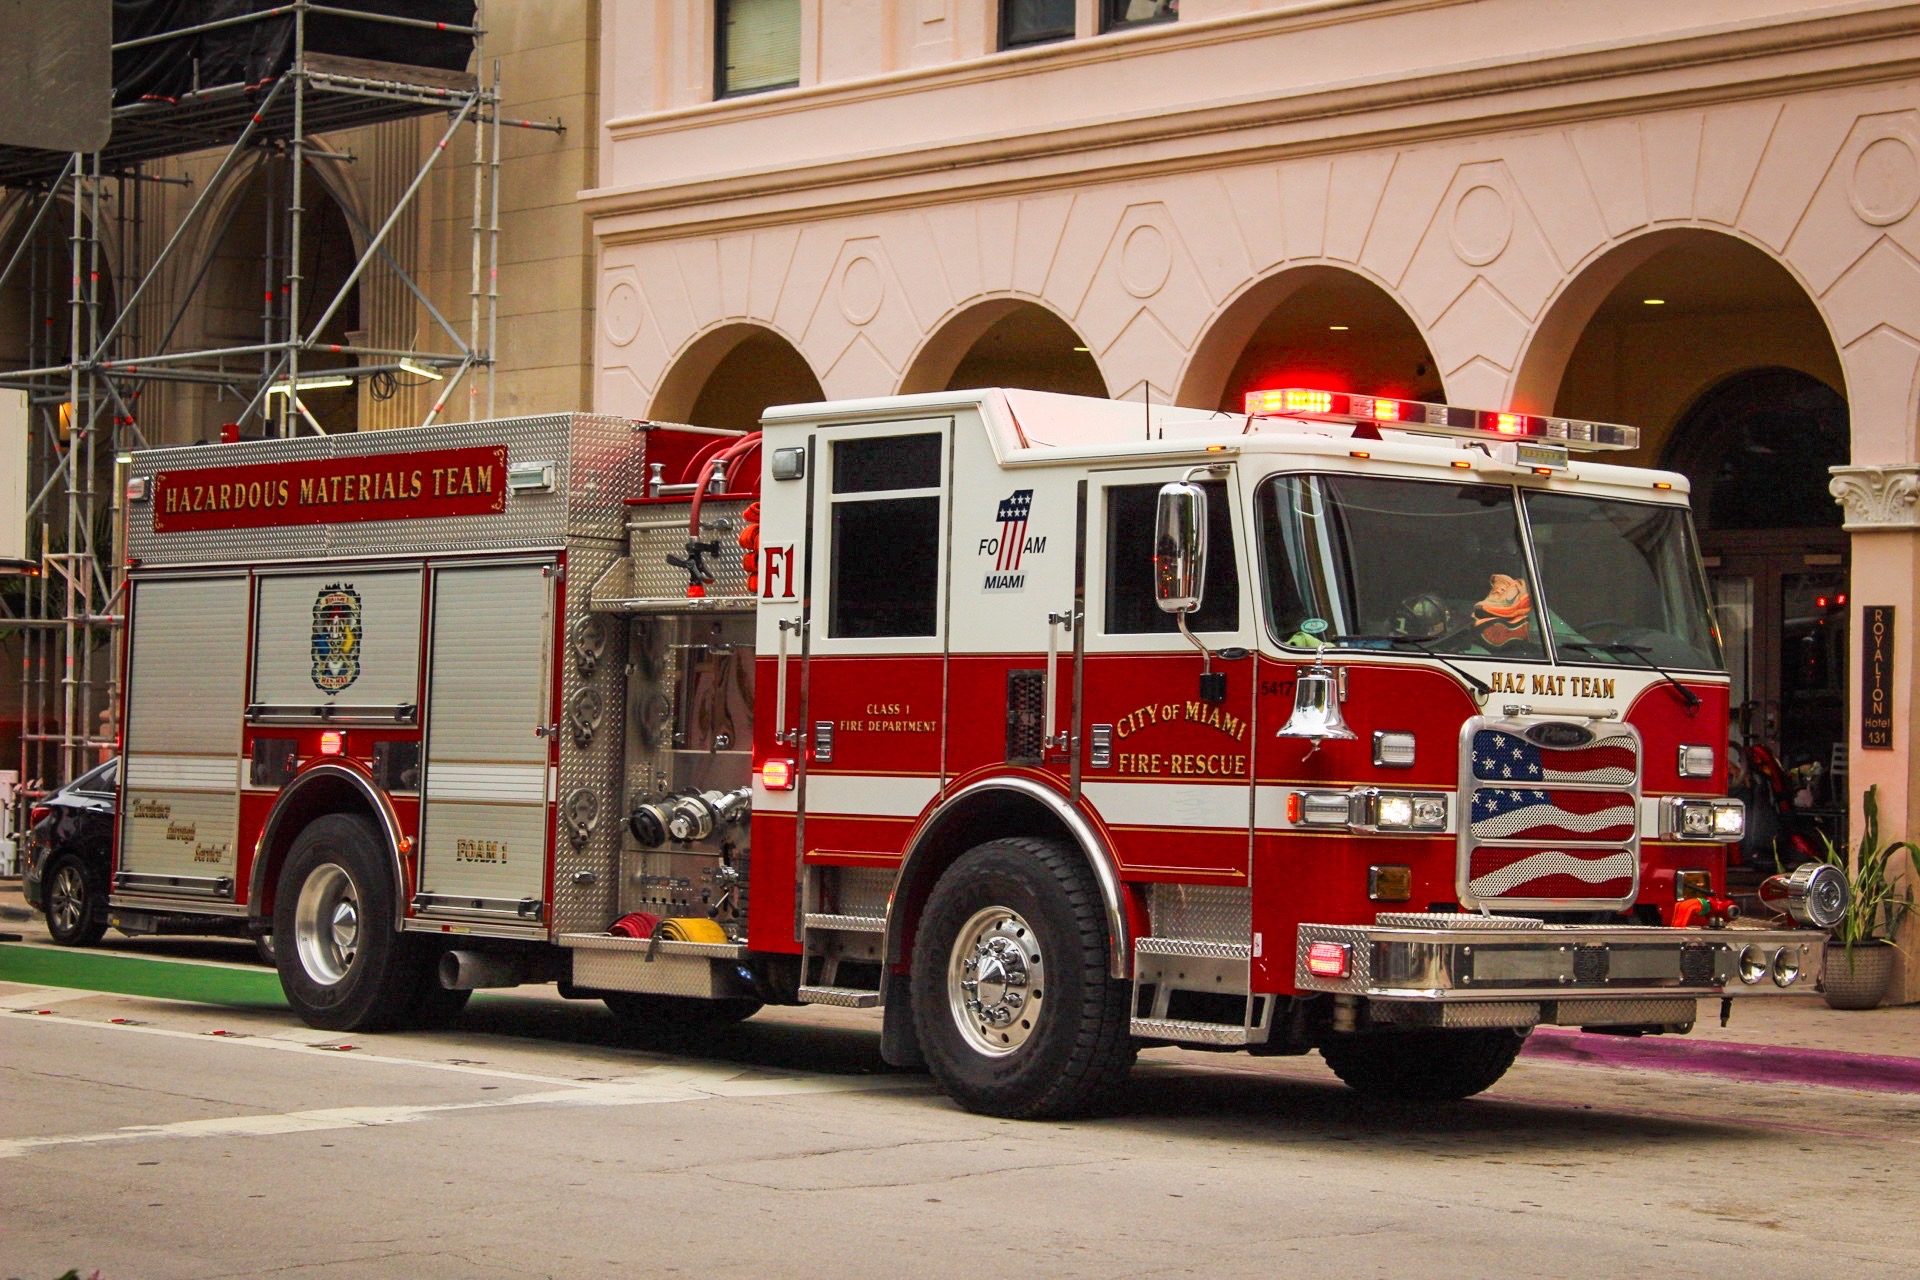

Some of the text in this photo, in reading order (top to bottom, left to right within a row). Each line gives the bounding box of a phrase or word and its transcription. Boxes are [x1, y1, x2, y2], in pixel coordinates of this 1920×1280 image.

[166, 465, 493, 514] HAZARDOUS MATERIALS TEAM
[762, 543, 796, 598] F1
[984, 574, 1025, 589] MIAMI
[1872, 609, 1885, 715] ROYALTON
[1261, 680, 1293, 696] 5417
[1491, 672, 1615, 698] HAZ MAT TEAM
[866, 703, 900, 715] CLASS
[840, 720, 937, 733] FIRE DEPARTMENT
[1117, 701, 1247, 742] CITY OF MIAMI
[1865, 717, 1890, 728] Hotel
[1868, 732, 1886, 744] 131
